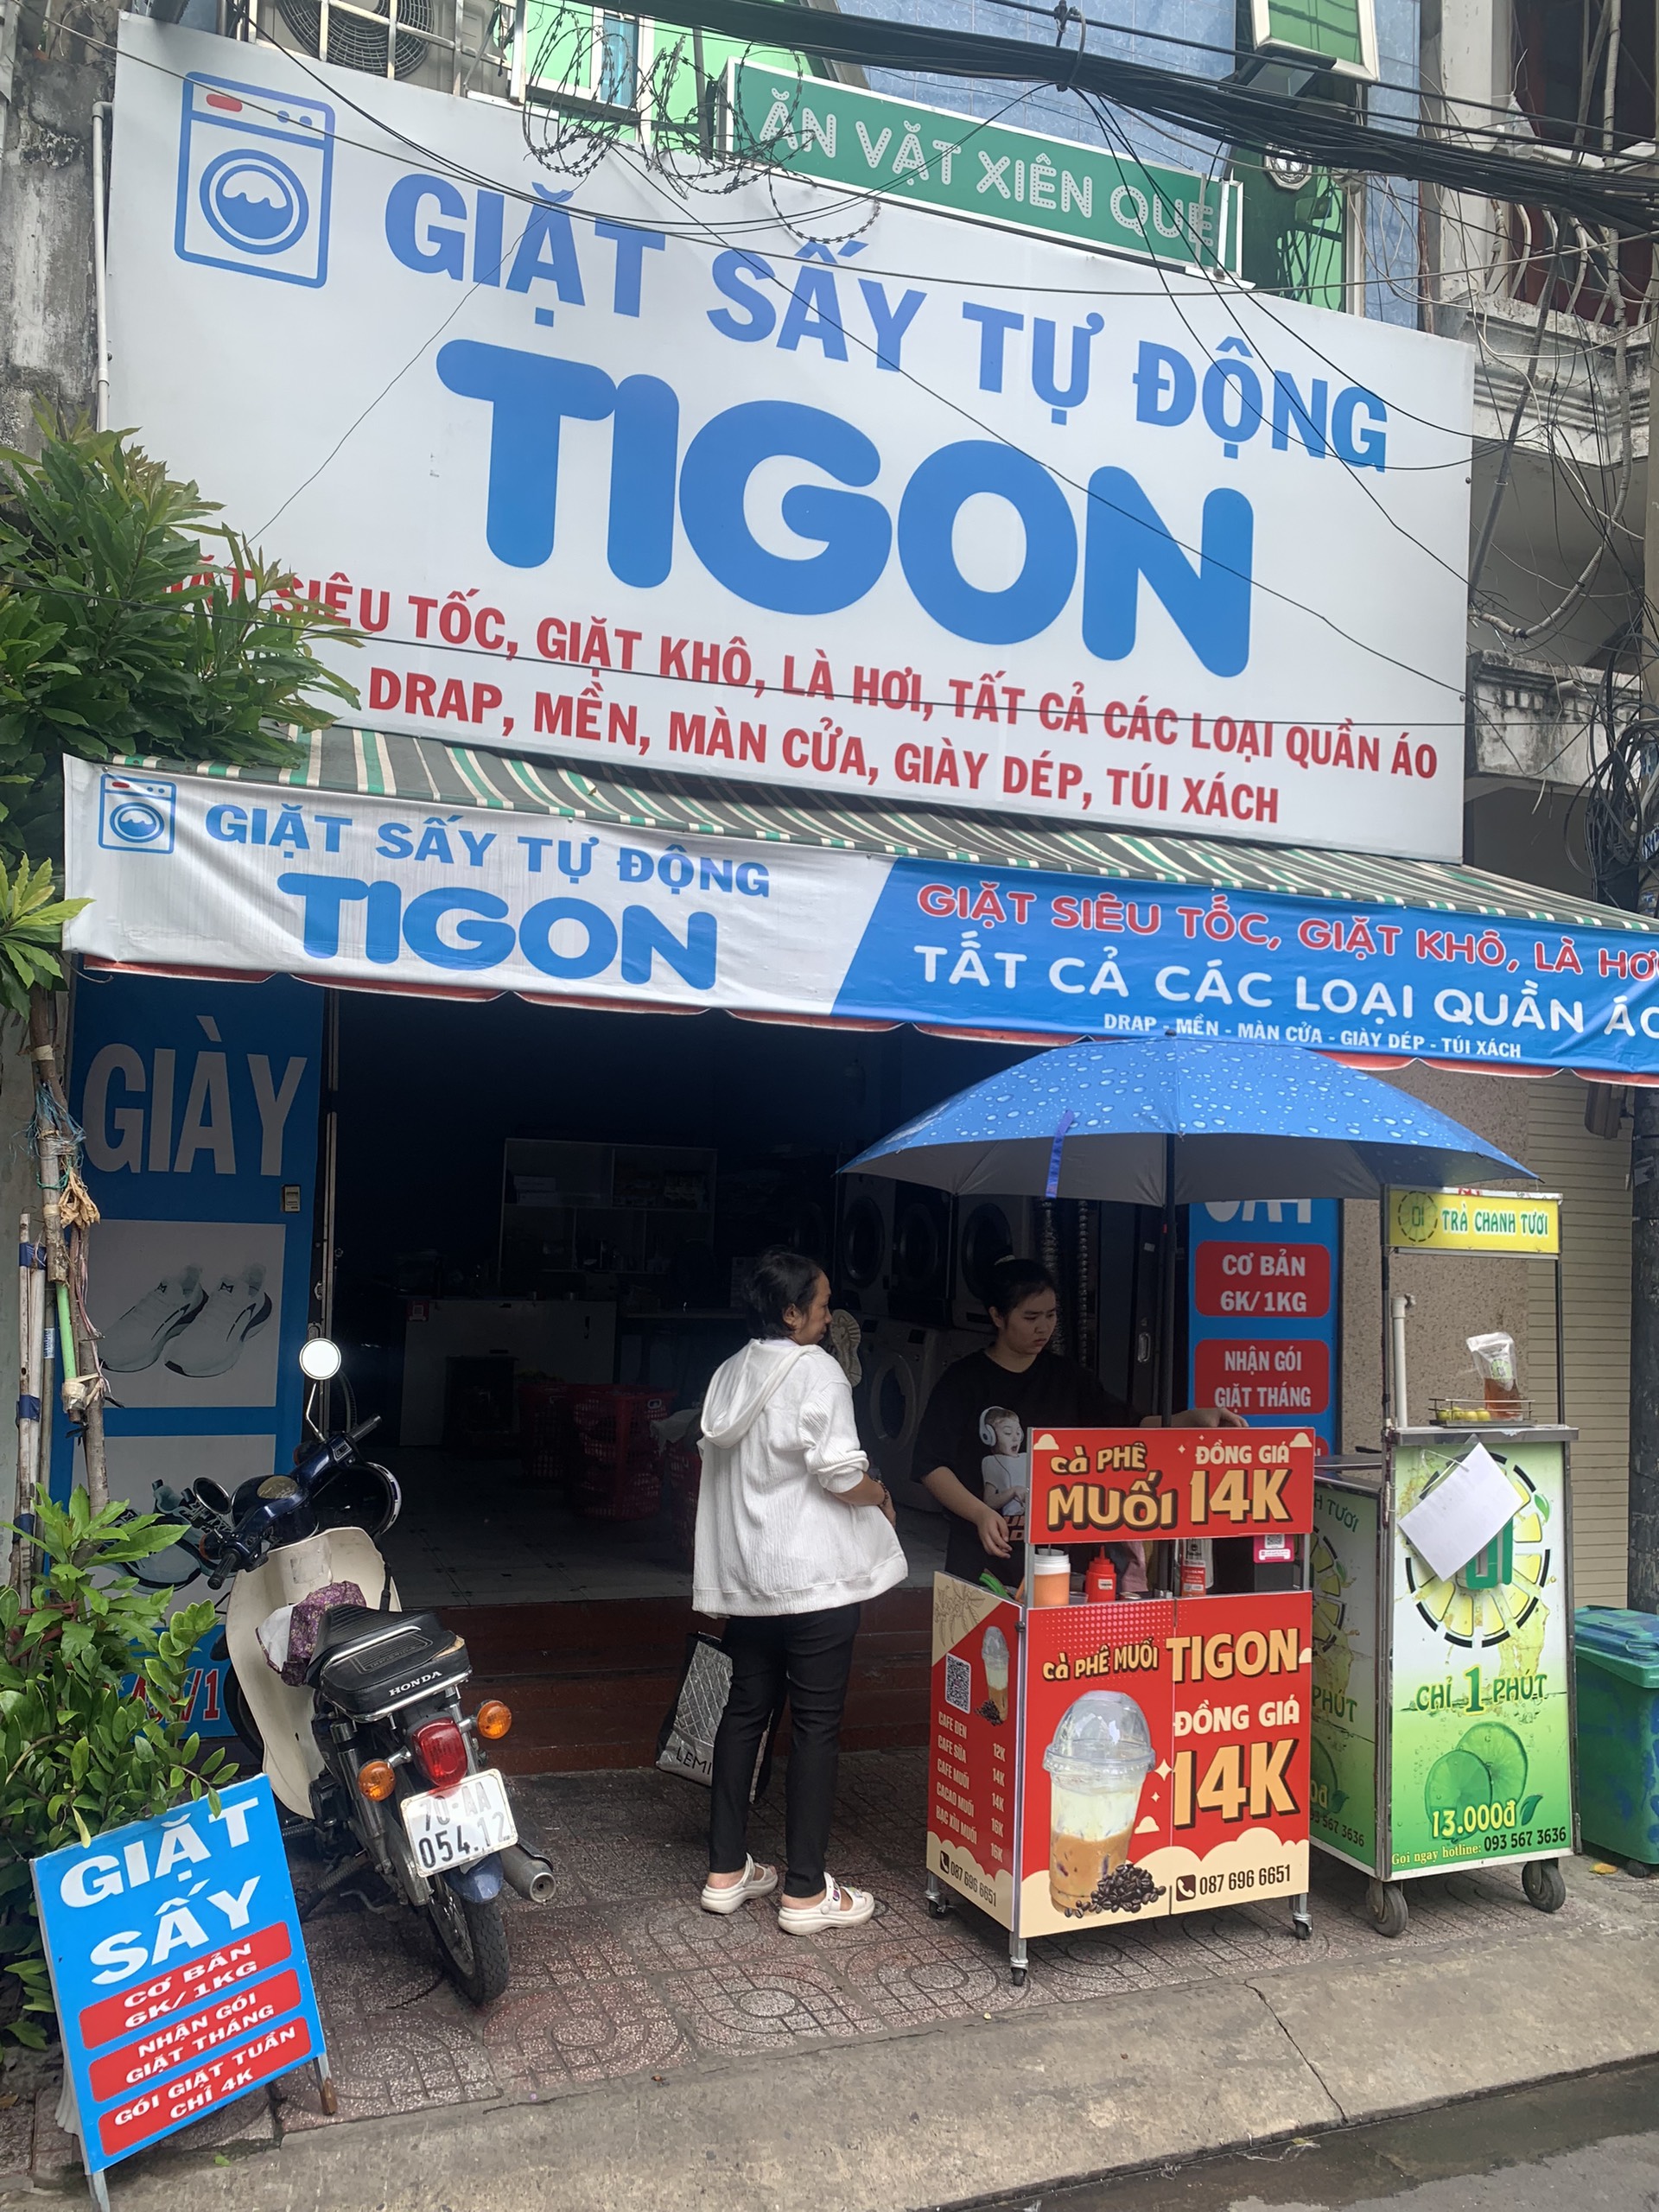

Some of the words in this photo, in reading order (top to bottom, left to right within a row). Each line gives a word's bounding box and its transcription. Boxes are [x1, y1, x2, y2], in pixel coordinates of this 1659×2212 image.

[759, 88, 836, 158] ĂN
[855, 120, 962, 187] VẶT
[976, 152, 1093, 218] XIÊN
[1109, 185, 1215, 247] QUE
[385, 173, 666, 328] GIẶT
[706, 240, 927, 373] SẤY
[963, 302, 1105, 426] TỰ
[1133, 335, 1389, 474] ĐỘNG
[435, 338, 1254, 678] TIGON
[273, 572, 390, 632] SIÊU
[409, 588, 518, 661] TỐC,
[536, 616, 642, 677] GIẶT
[660, 636, 767, 699] KHÔ,
[783, 648, 835, 700] LÀ
[853, 665, 933, 721] HƠI,
[949, 671, 1026, 725] TẤT
[1039, 682, 1089, 734] CẢ
[1103, 695, 1179, 747] CÁC
[1191, 712, 1273, 763] LOẠI
[1286, 718, 1380, 772] QUẦN
[1391, 732, 1438, 779] ÁO
[368, 666, 515, 737] DRAP,
[534, 681, 651, 756] MỀN,
[669, 707, 767, 763] MÀN
[782, 716, 879, 785] CỬA,
[894, 738, 988, 791] GIÀY
[1002, 750, 1092, 810] DÉP,
[1107, 763, 1168, 811] TÚI
[1181, 772, 1279, 823] XÁCH
[206, 804, 353, 859] GIẶT
[375, 815, 498, 868] SẤY
[518, 836, 601, 884] TỰ
[616, 844, 770, 898] ĐỘNG
[276, 872, 716, 991] TIGON
[917, 880, 1037, 930] GIẶT
[1051, 892, 1161, 936] SIÊU
[1176, 894, 1281, 950] TỐC,
[1298, 916, 1402, 961] GIẶT
[1415, 929, 1520, 973] KHÔ,
[1534, 936, 1583, 975] LÀ
[1599, 947, 1659, 982] HƠ
[913, 930, 1027, 989] TẤT
[1048, 945, 1129, 998] CẢ
[1154, 957, 1273, 1008] CÁC
[1295, 976, 1414, 1026] LOẠI
[1433, 979, 1584, 1034] QUẦN
[1104, 1014, 1157, 1033] DRAP
[1176, 1013, 1219, 1037] MỀN
[1237, 1019, 1279, 1042] MÀN
[1286, 1021, 1323, 1044] CỬA
[1341, 1025, 1381, 1048] GIÀY
[1388, 1030, 1425, 1051] DÉP
[1441, 1033, 1471, 1054] TÚI
[1476, 1037, 1522, 1059] XÁCH
[81, 1015, 308, 1177] GIÀY
[1441, 1203, 1468, 1232] TRÀ
[1474, 1211, 1516, 1234] CHANH
[1520, 1211, 1548, 1236] TƯƠI
[1222, 1252, 1254, 1276] CƠ
[1260, 1249, 1306, 1276] BẢN
[1224, 1345, 1269, 1376] NHẬN
[1274, 1345, 1301, 1371] GÓI
[1214, 1382, 1252, 1414] GIẶT
[1257, 1382, 1312, 1408] THÁNG
[1096, 1441, 1147, 1471] PHÊ
[1195, 1440, 1252, 1465] ĐỒNG
[1259, 1441, 1289, 1464] GIÁ
[1046, 1471, 1179, 1532] MUỐI
[1189, 1469, 1293, 1524] 14K
[1327, 1499, 1360, 1533] TƯƠI
[1075, 1645, 1110, 1678] PHÊ
[1114, 1637, 1159, 1673] MUỐI
[1166, 1628, 1300, 1684] TIGON
[389, 1671, 442, 1697] HONDA
[1312, 1685, 1358, 1723] PHÚT
[1415, 1675, 1452, 1711] CHỈ
[1464, 1666, 1484, 1713] 1
[1492, 1669, 1548, 1703] PHÚT
[1173, 1699, 1249, 1737] ĐỒNG
[1258, 1694, 1300, 1728] GIÁ
[993, 1743, 1006, 1762] 12K
[992, 1768, 1005, 1787] 14K
[1172, 1738, 1300, 1830] 14K
[991, 1792, 1004, 1813] 14K
[1432, 1800, 1516, 1838] 13.000đ
[418, 1811, 508, 1868] 054.12
[991, 1817, 1003, 1838] 16K
[1322, 1815, 1339, 1834] 567
[1341, 1824, 1364, 1847] 3636
[1392, 1852, 1410, 1866] Gọi
[1414, 1849, 1439, 1864] ngay
[1442, 1842, 1482, 1859] hotline:
[1484, 1834, 1507, 1852] 093
[1510, 1830, 1533, 1848] 567
[1537, 1826, 1567, 1846] 3636
[60, 1796, 259, 1909] GIẶT
[950, 1861, 963, 1881] 087
[964, 1871, 978, 1893] 696
[979, 1882, 996, 1907] 6651
[1199, 1874, 1224, 1895] 087
[1229, 1870, 1254, 1891] 696
[1258, 1865, 1290, 1885] 6651
[89, 1875, 262, 1986] SẤY
[124, 1976, 172, 2007] CƠ
[182, 1943, 251, 1983] BẢN
[125, 2046, 184, 2084] GIẶT
[192, 2004, 275, 2051] THÁNG
[137, 2015, 208, 2058] NHẬN
[215, 1992, 257, 2020] GÓI
[114, 2094, 159, 2126] GÓI
[167, 2062, 224, 2099] GIẶT
[232, 2025, 296, 2066] TUẦN
[169, 2084, 213, 2119] CHỈ
[220, 2068, 254, 2093] 4K
